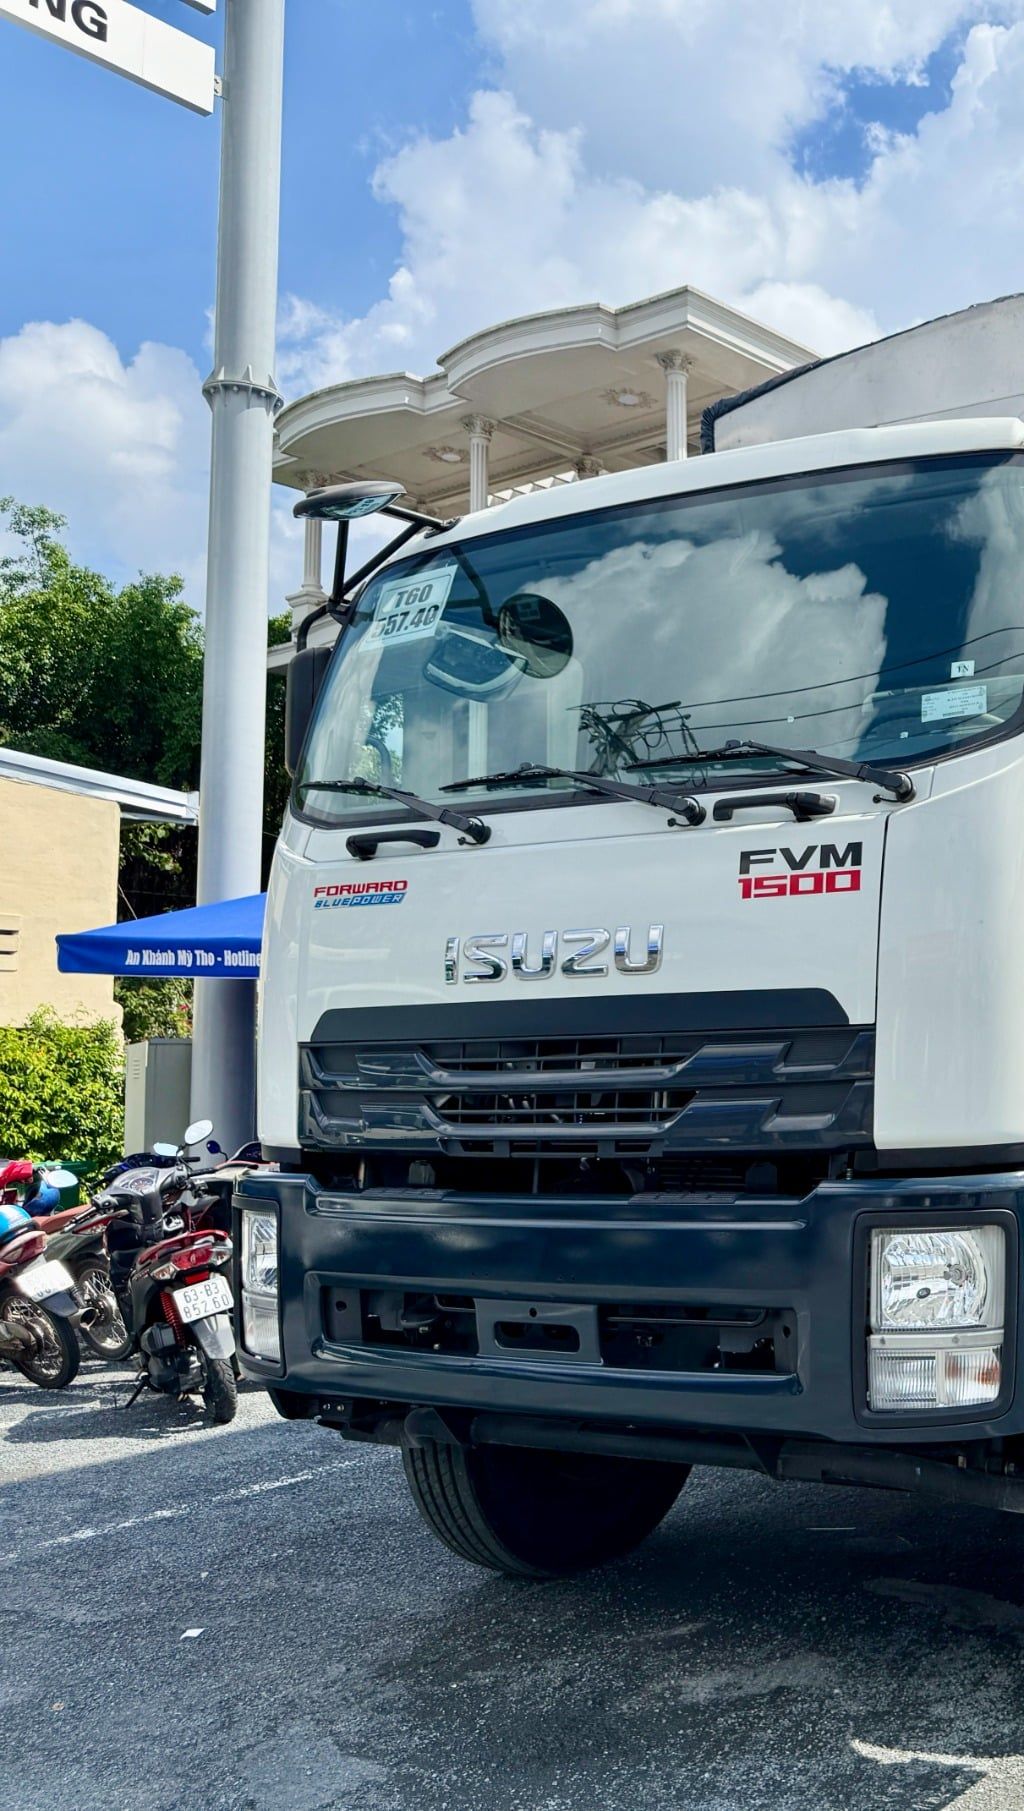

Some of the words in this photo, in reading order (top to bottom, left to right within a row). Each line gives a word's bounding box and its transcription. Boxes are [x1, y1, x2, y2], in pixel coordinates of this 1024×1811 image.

[394, 583, 434, 609] T60
[738, 841, 863, 875] FVM
[313, 879, 409, 898] FORWARD
[737, 869, 862, 900] 1500
[313, 892, 405, 908] BLUEPOWER
[125, 950, 140, 966] An
[195, 949, 215, 967] Tho
[223, 949, 262, 967] Hotline
[443, 922, 666, 986] ISUZU
